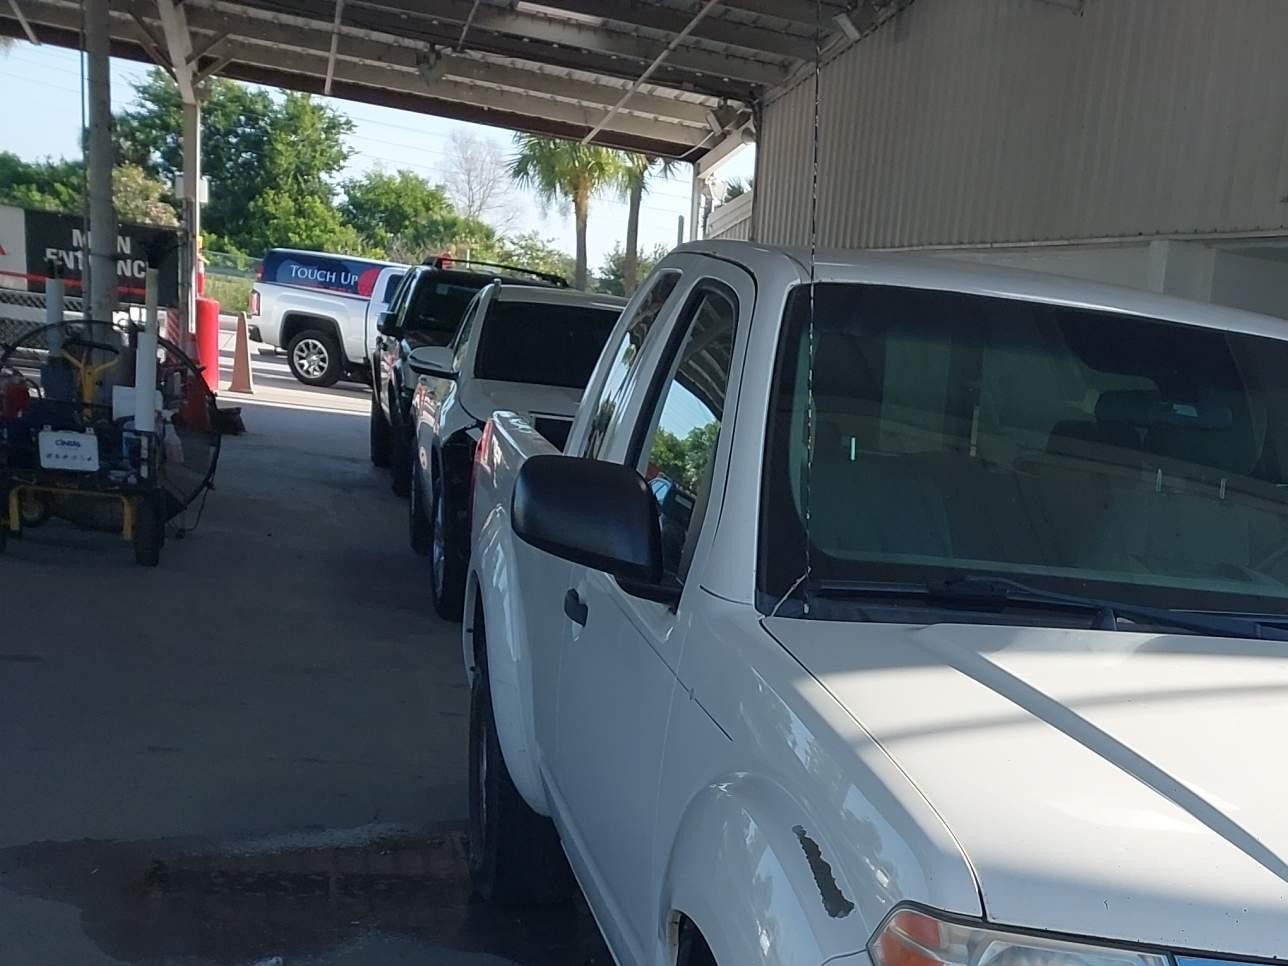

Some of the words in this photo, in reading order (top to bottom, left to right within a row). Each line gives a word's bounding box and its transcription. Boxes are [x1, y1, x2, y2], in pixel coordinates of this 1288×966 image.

[71, 228, 131, 255] MN
[288, 263, 336, 283] TOUCH
[340, 270, 359, 286] UP
